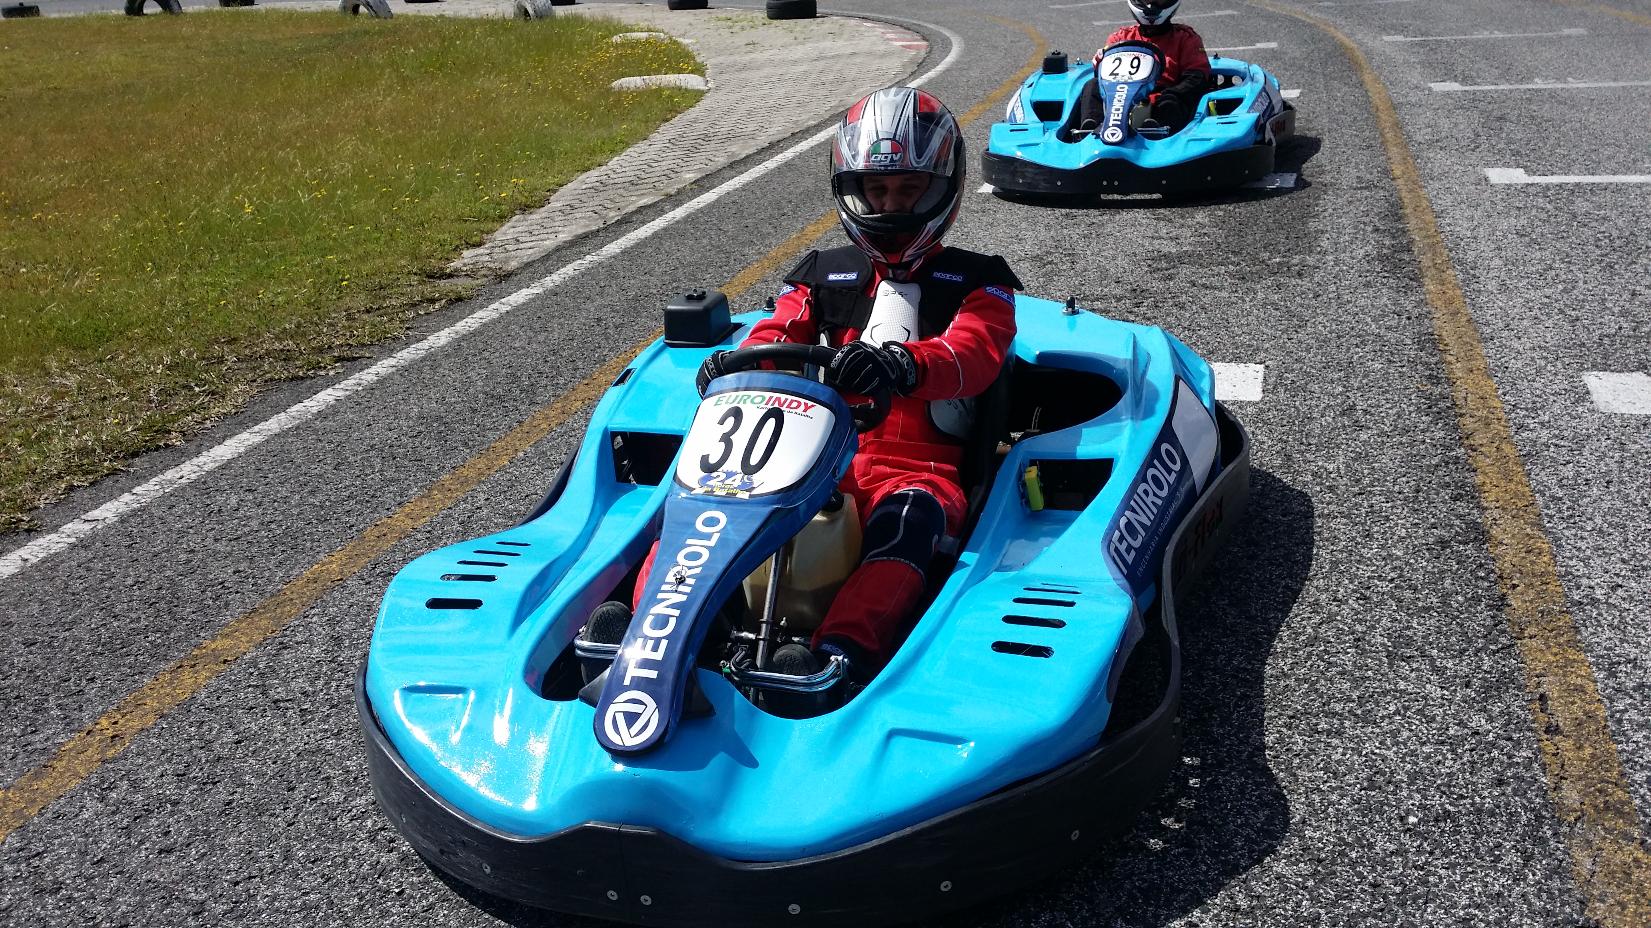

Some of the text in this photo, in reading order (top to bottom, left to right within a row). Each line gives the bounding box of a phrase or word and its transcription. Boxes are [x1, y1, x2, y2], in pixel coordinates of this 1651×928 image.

[1109, 56, 1141, 77] 29
[871, 153, 903, 166] agv
[714, 394, 816, 413] EUROINDY
[699, 405, 785, 475] 30
[1109, 442, 1182, 576] TECNIROLO
[623, 510, 728, 686] TECNIROLO
